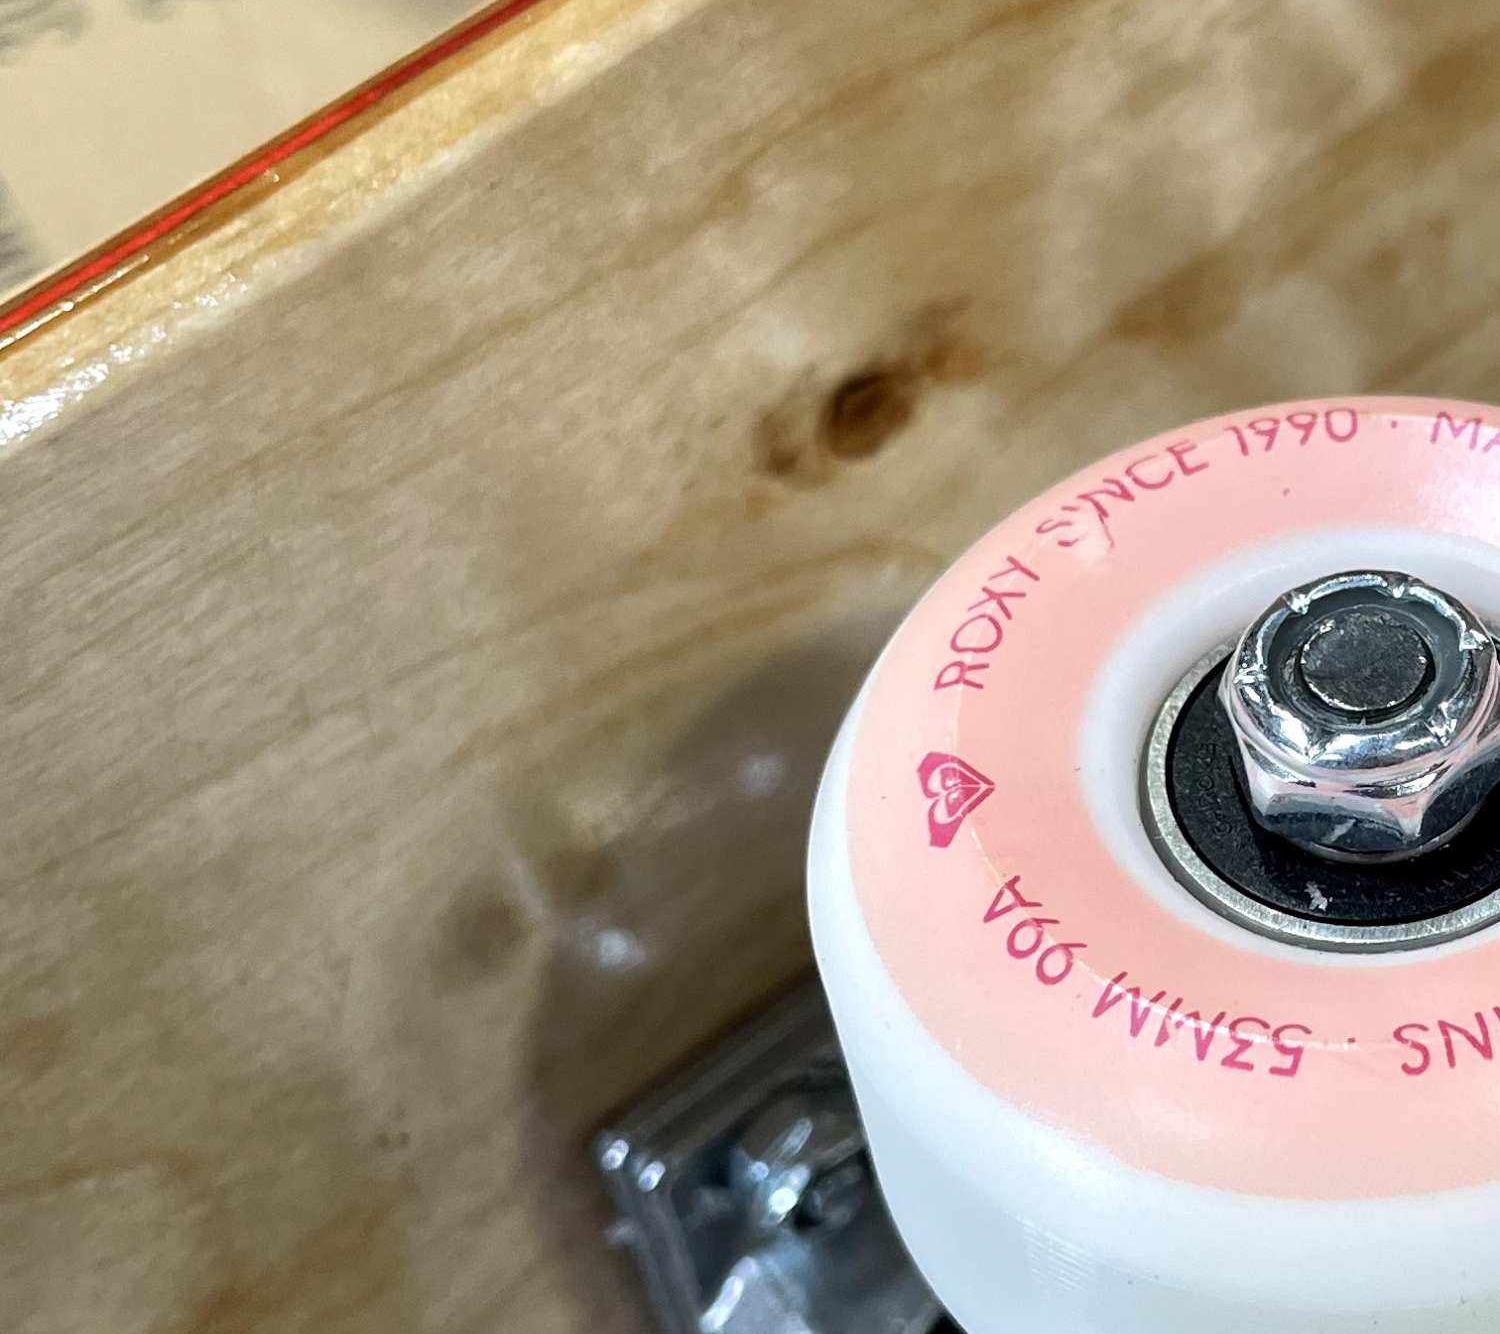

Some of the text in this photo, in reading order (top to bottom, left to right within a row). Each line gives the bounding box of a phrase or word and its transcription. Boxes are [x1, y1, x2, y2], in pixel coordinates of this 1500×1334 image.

[934, 407, 1359, 690] ROXY SINCE 1990
[983, 875, 1313, 1078] 53MM 99A
